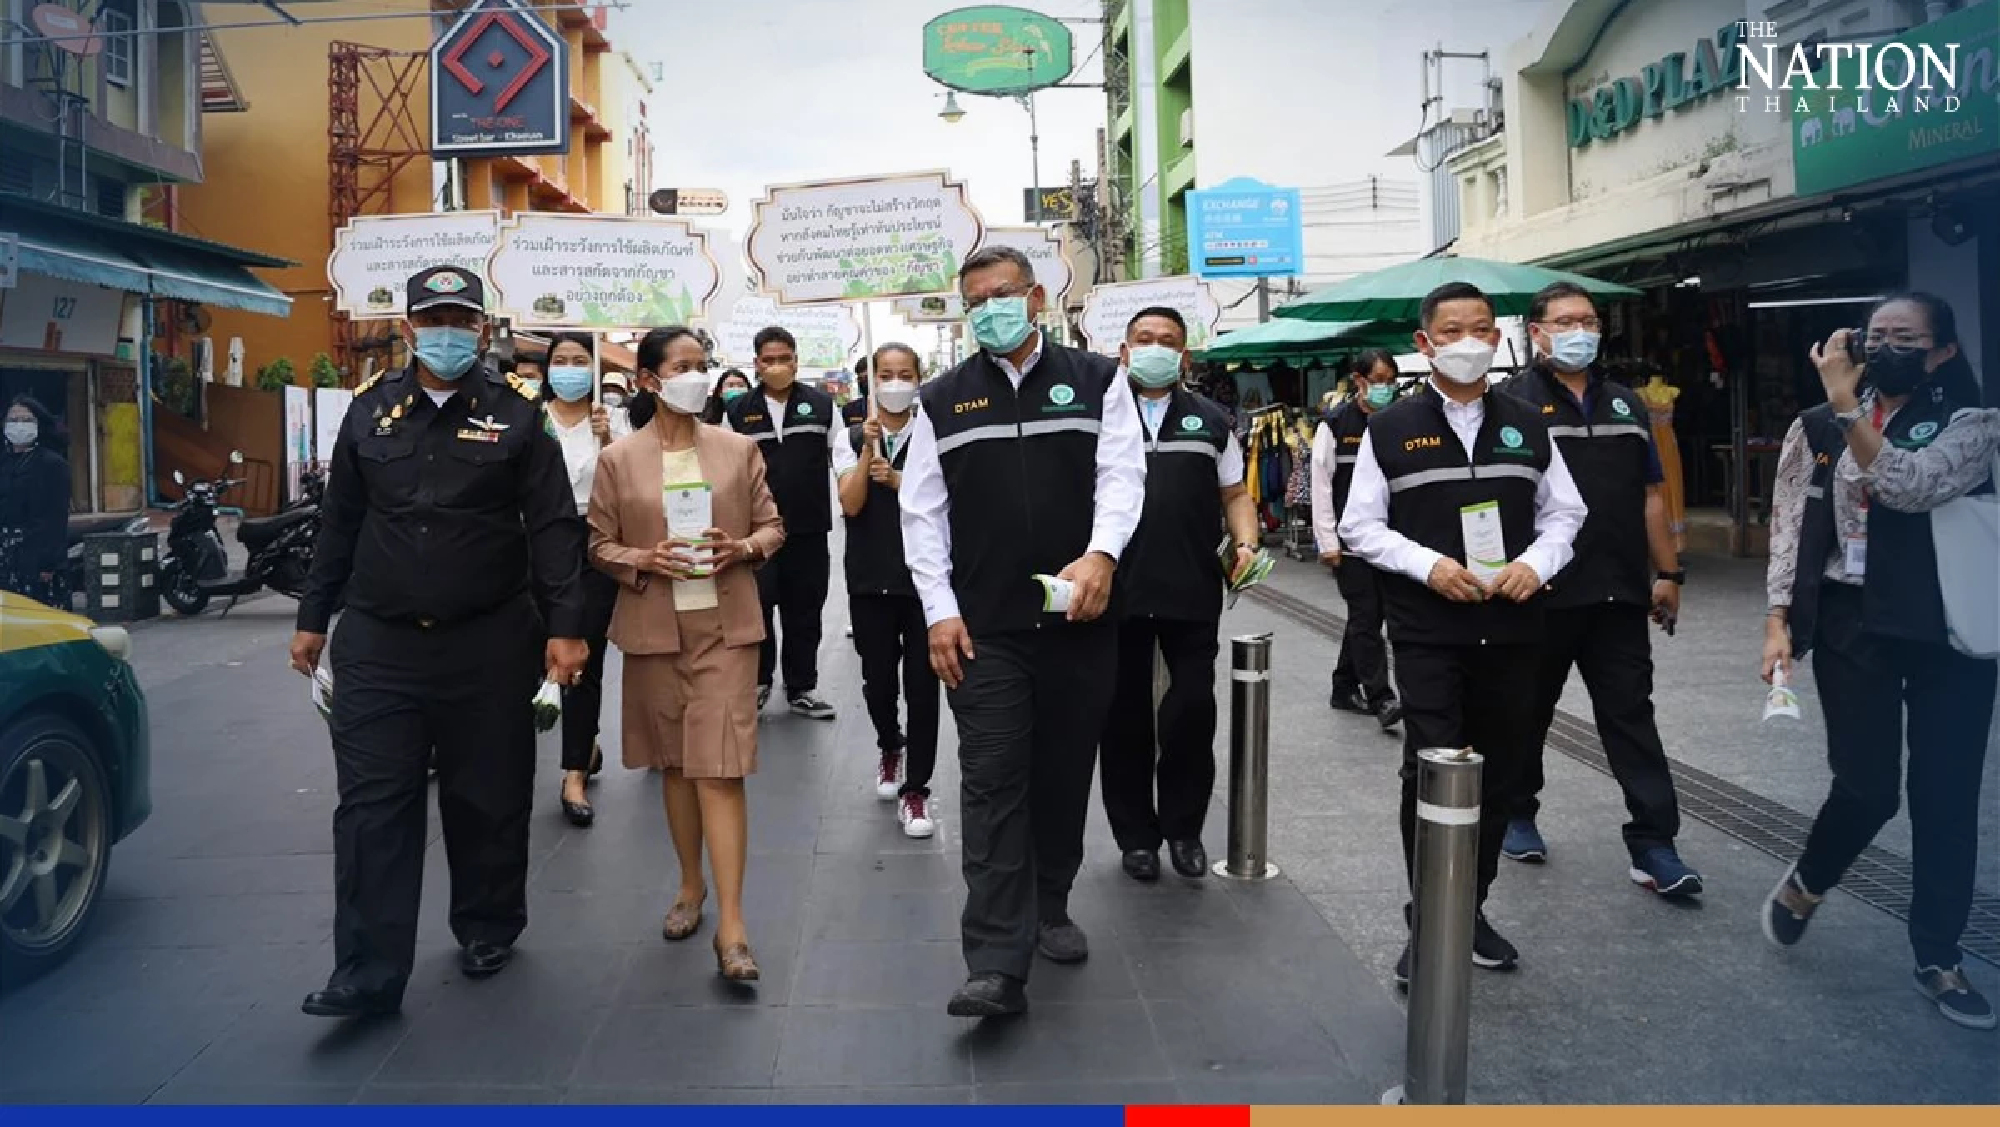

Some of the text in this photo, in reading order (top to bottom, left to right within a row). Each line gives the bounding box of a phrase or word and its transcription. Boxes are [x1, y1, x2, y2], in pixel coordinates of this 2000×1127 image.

[1862, 46, 2000, 128] Chan
[1567, 76, 1643, 148] D&D
[53, 296, 77, 319] 127
[954, 397, 989, 414] DTAM
[1404, 436, 1441, 451] DTAM
